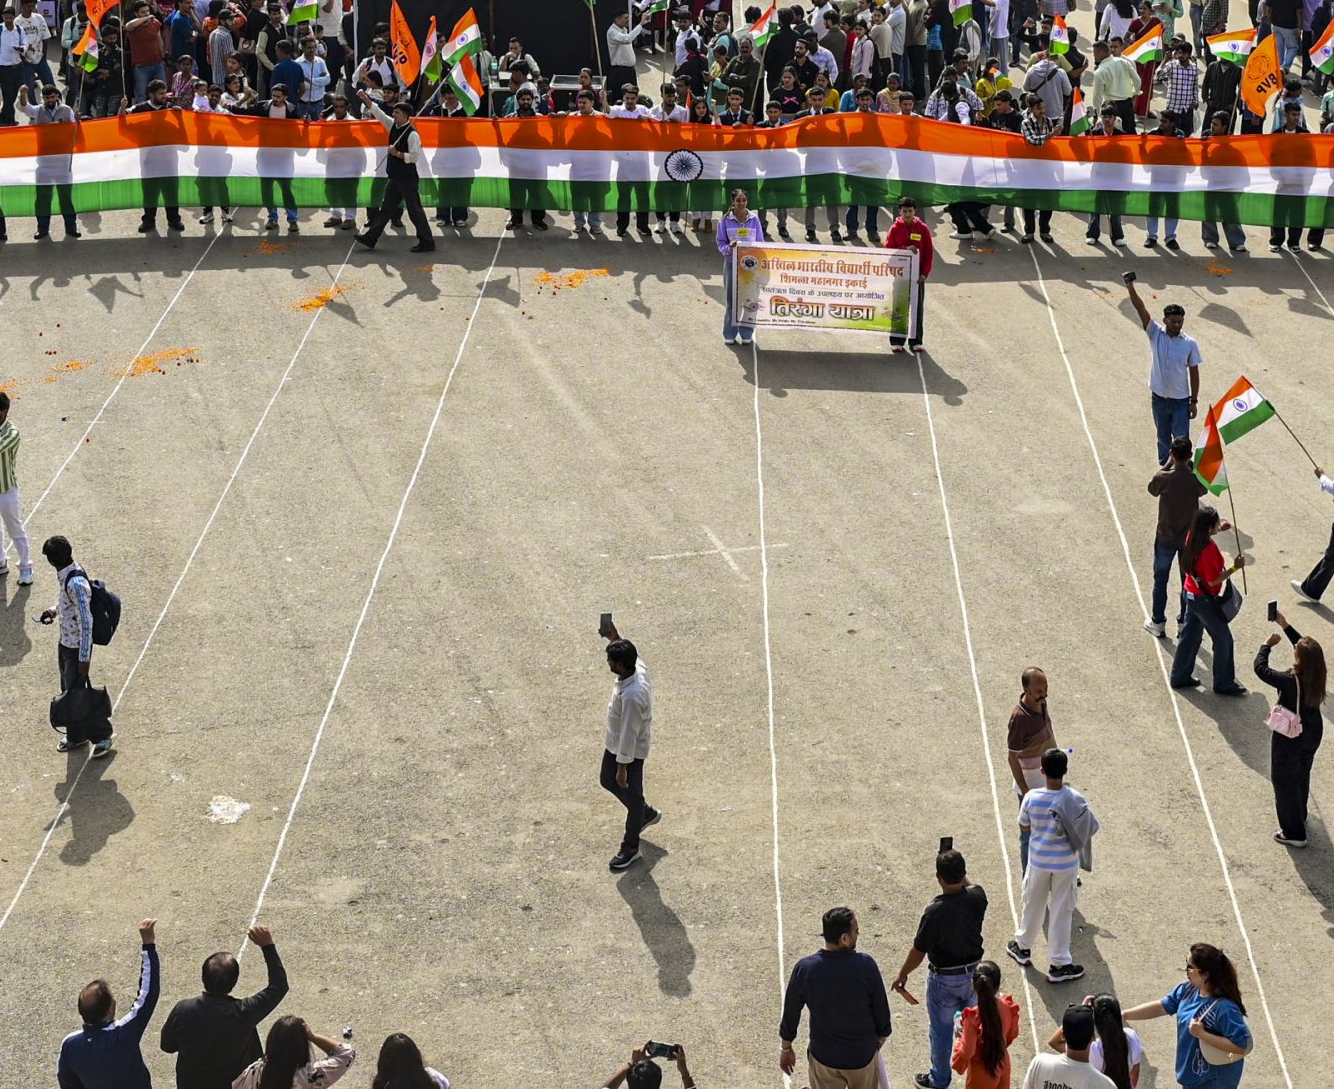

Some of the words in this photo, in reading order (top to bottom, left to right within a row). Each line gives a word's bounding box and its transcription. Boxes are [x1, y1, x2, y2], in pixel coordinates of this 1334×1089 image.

[762, 257, 796, 271] अखिल
[798, 259, 834, 273] भारतीय
[837, 260, 871, 275] विद्यार्थी
[873, 262, 904, 277] परिषद
[780, 272, 808, 284] शिमला
[811, 275, 843, 287] महानगर
[845, 277, 867, 289] इकाई
[770, 295, 825, 318] तिरंगा
[829, 303, 875, 321] यात्रा
